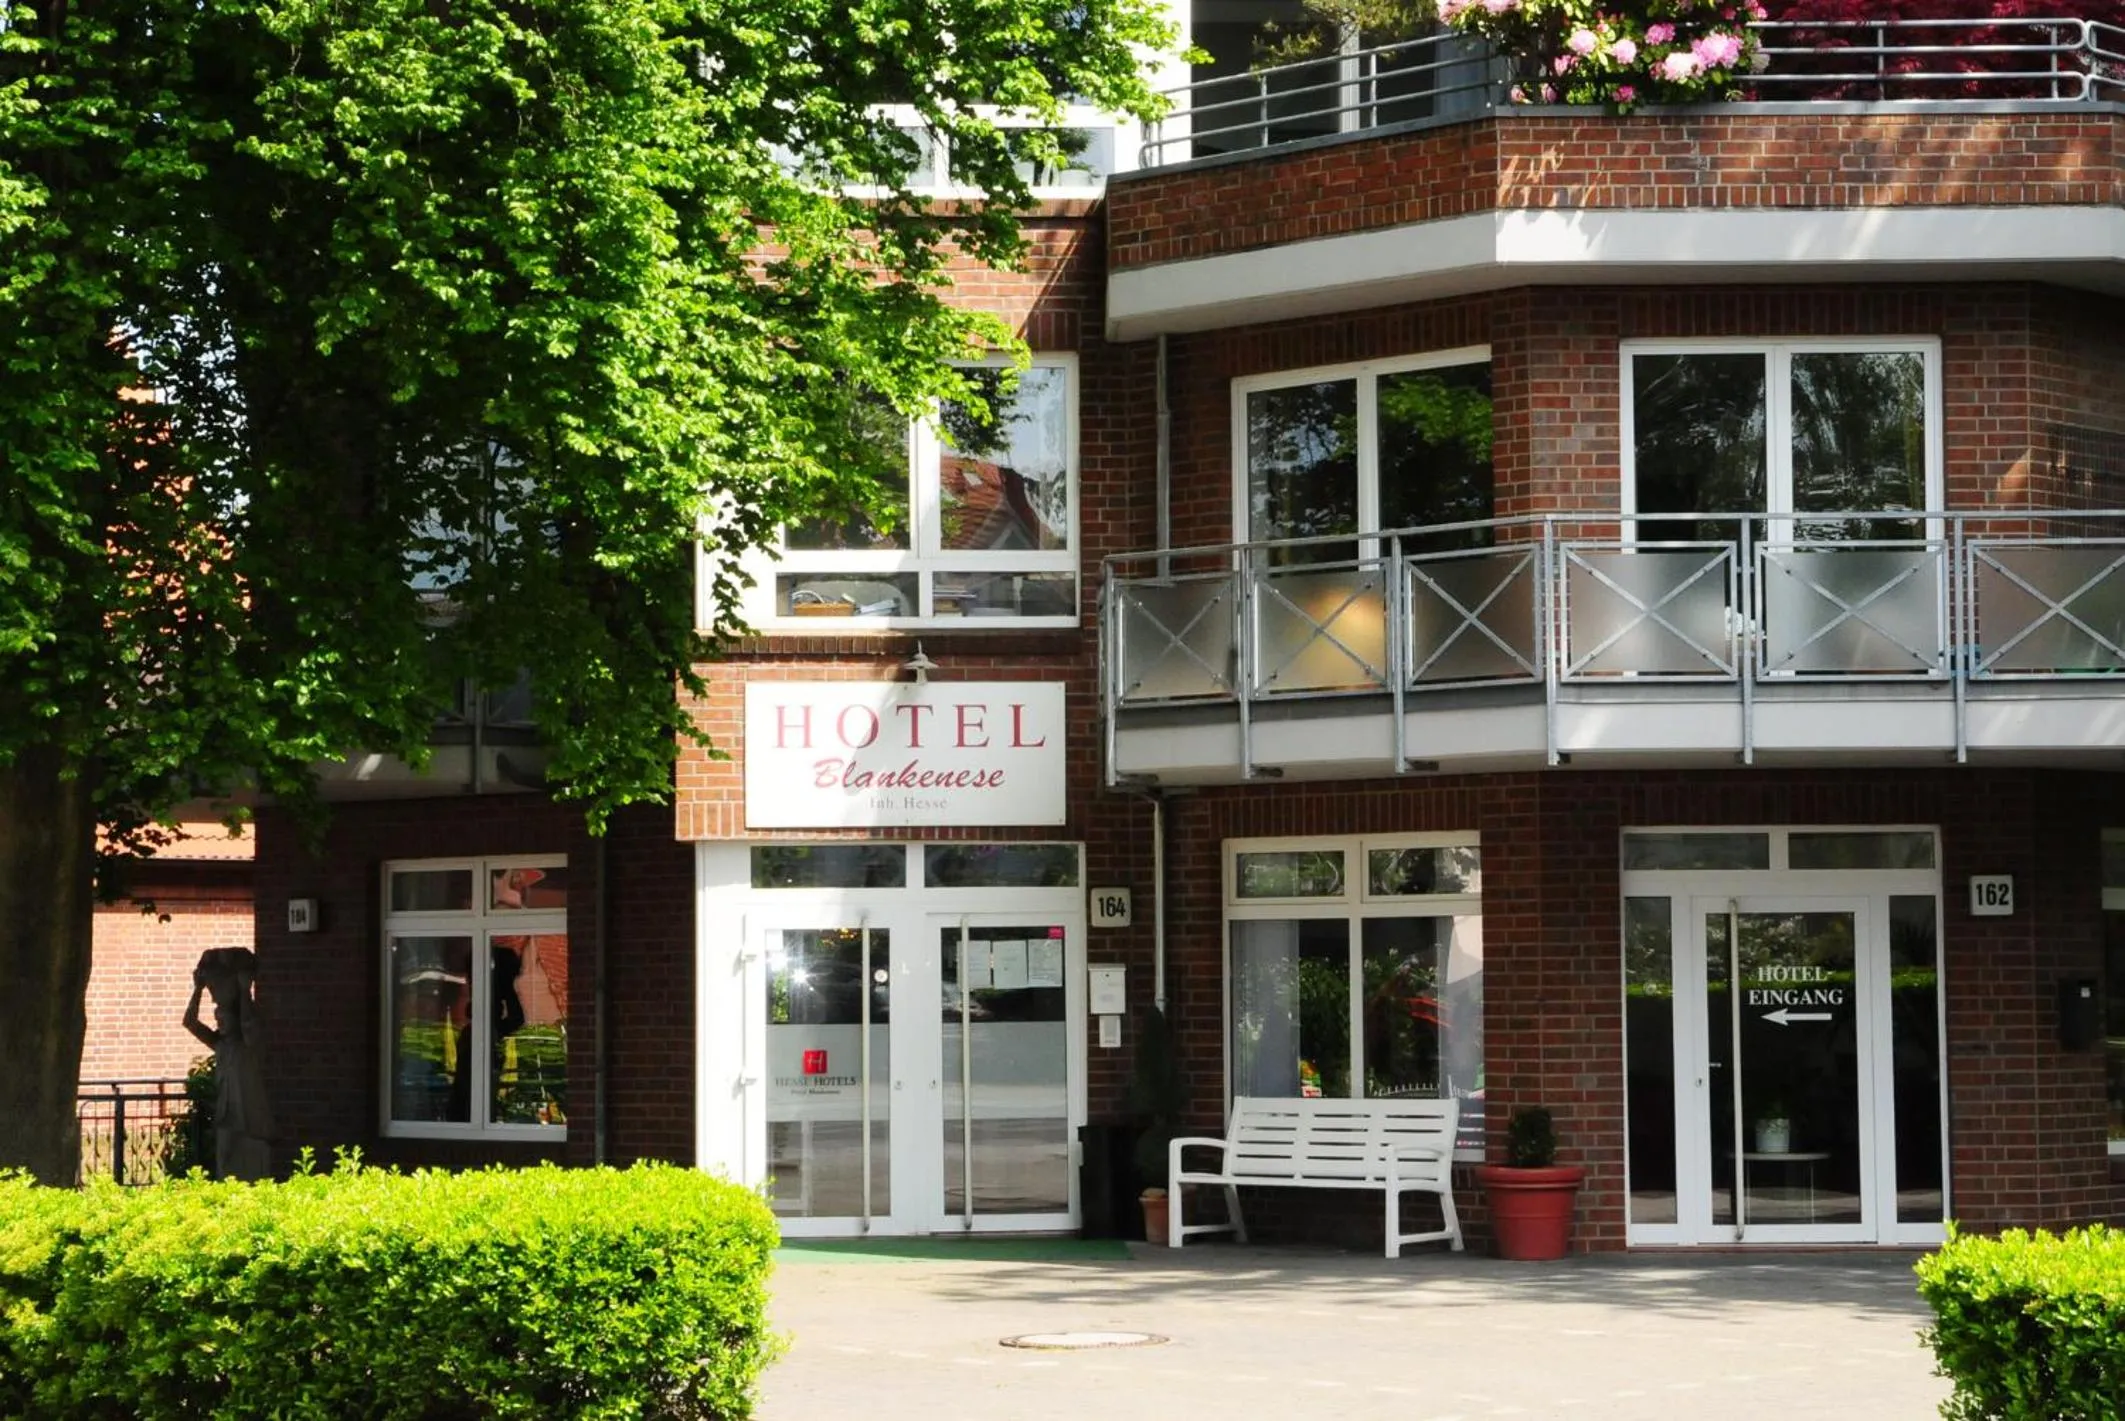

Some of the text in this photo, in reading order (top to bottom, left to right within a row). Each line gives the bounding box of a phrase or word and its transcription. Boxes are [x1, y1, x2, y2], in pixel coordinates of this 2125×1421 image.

[775, 704, 1046, 749] HOTEL
[812, 757, 1006, 789] Blankenese
[903, 796, 948, 809] Hesse
[1976, 883, 2009, 906] 162
[1098, 896, 1126, 917] 164
[1748, 989, 1843, 1005] EINGANG
[814, 1076, 857, 1086] HOTELS
